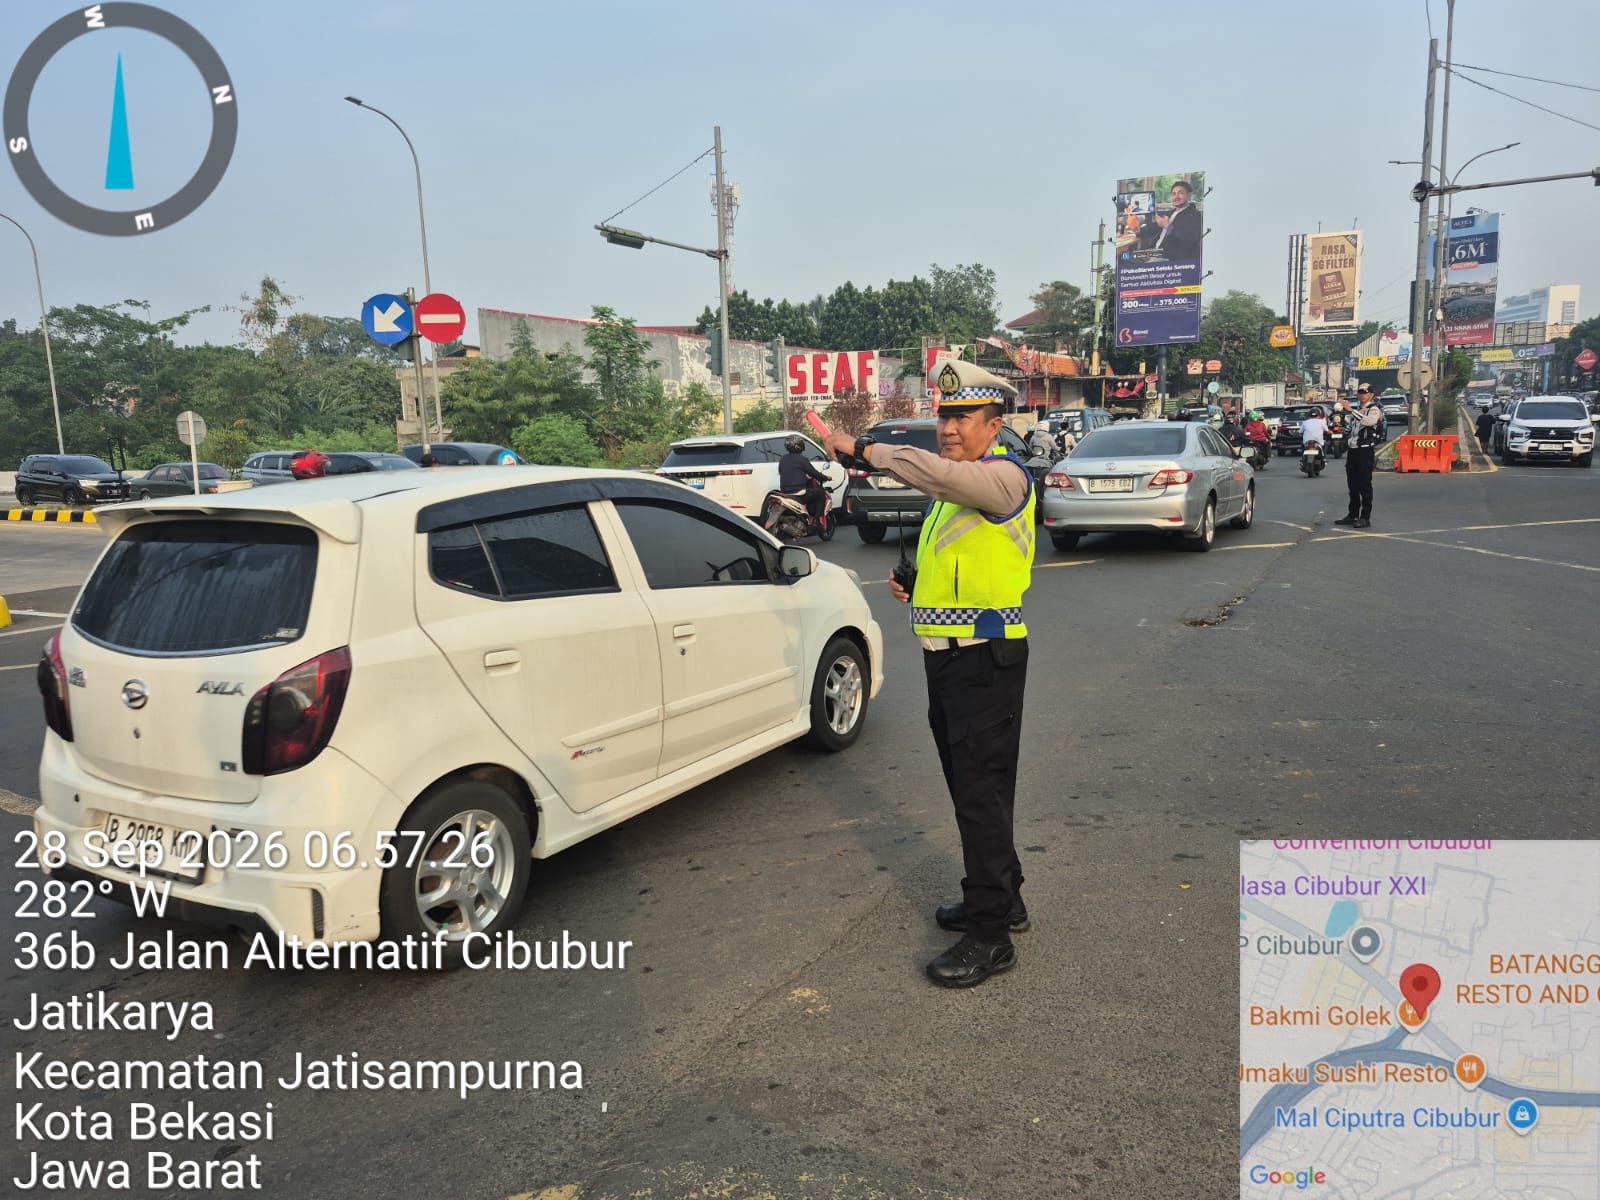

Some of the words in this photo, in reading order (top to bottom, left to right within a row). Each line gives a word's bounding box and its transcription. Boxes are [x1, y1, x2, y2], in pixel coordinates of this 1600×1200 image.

[1321, 244, 1346, 255] RASA
[1312, 259, 1325, 270] GG
[1326, 257, 1355, 269] FILTER
[1122, 300, 1139, 309] 300
[196, 680, 246, 696] AYLA
[108, 818, 120, 843] B
